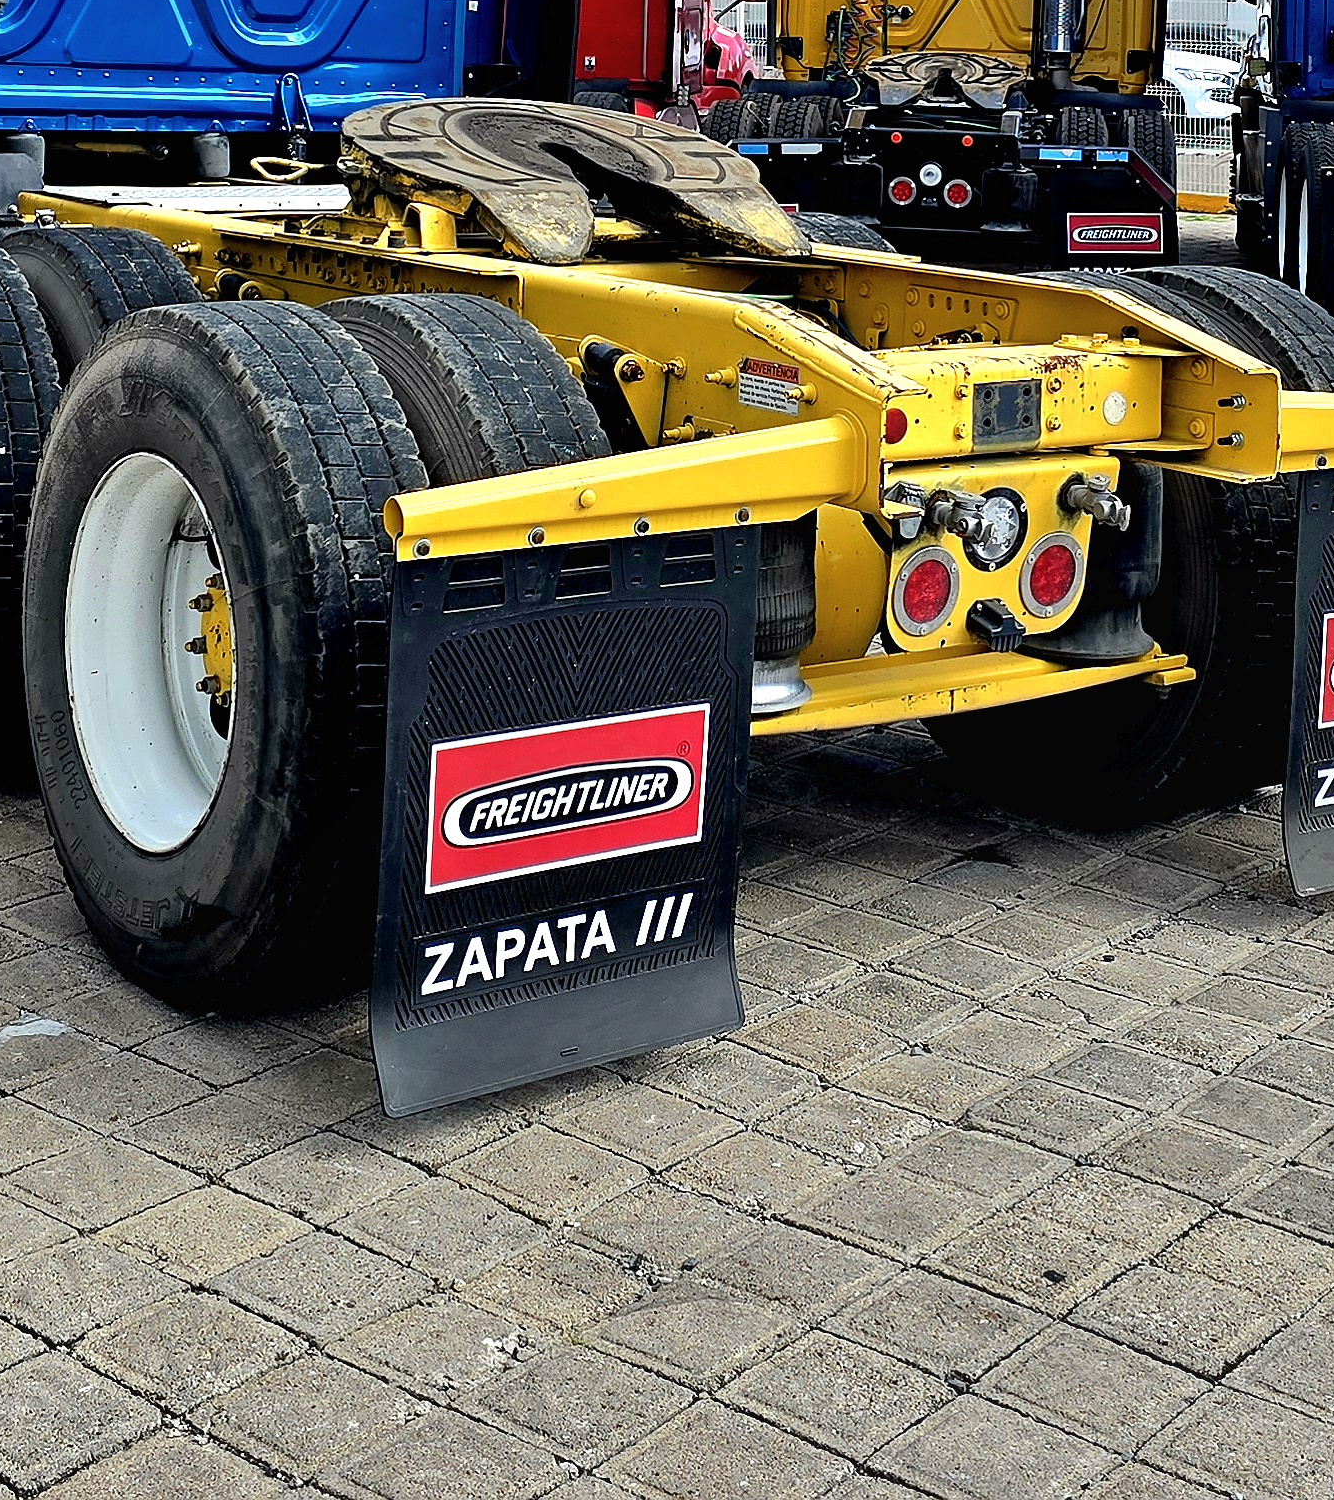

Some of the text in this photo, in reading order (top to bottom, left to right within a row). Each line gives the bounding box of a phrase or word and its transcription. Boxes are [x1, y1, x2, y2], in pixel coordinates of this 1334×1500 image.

[1080, 229, 1150, 239] FREIGHTLINER
[747, 360, 799, 381] ADVERTENCIA
[469, 772, 670, 833] FREIGHTLINER
[421, 909, 617, 996] ZAPATA
